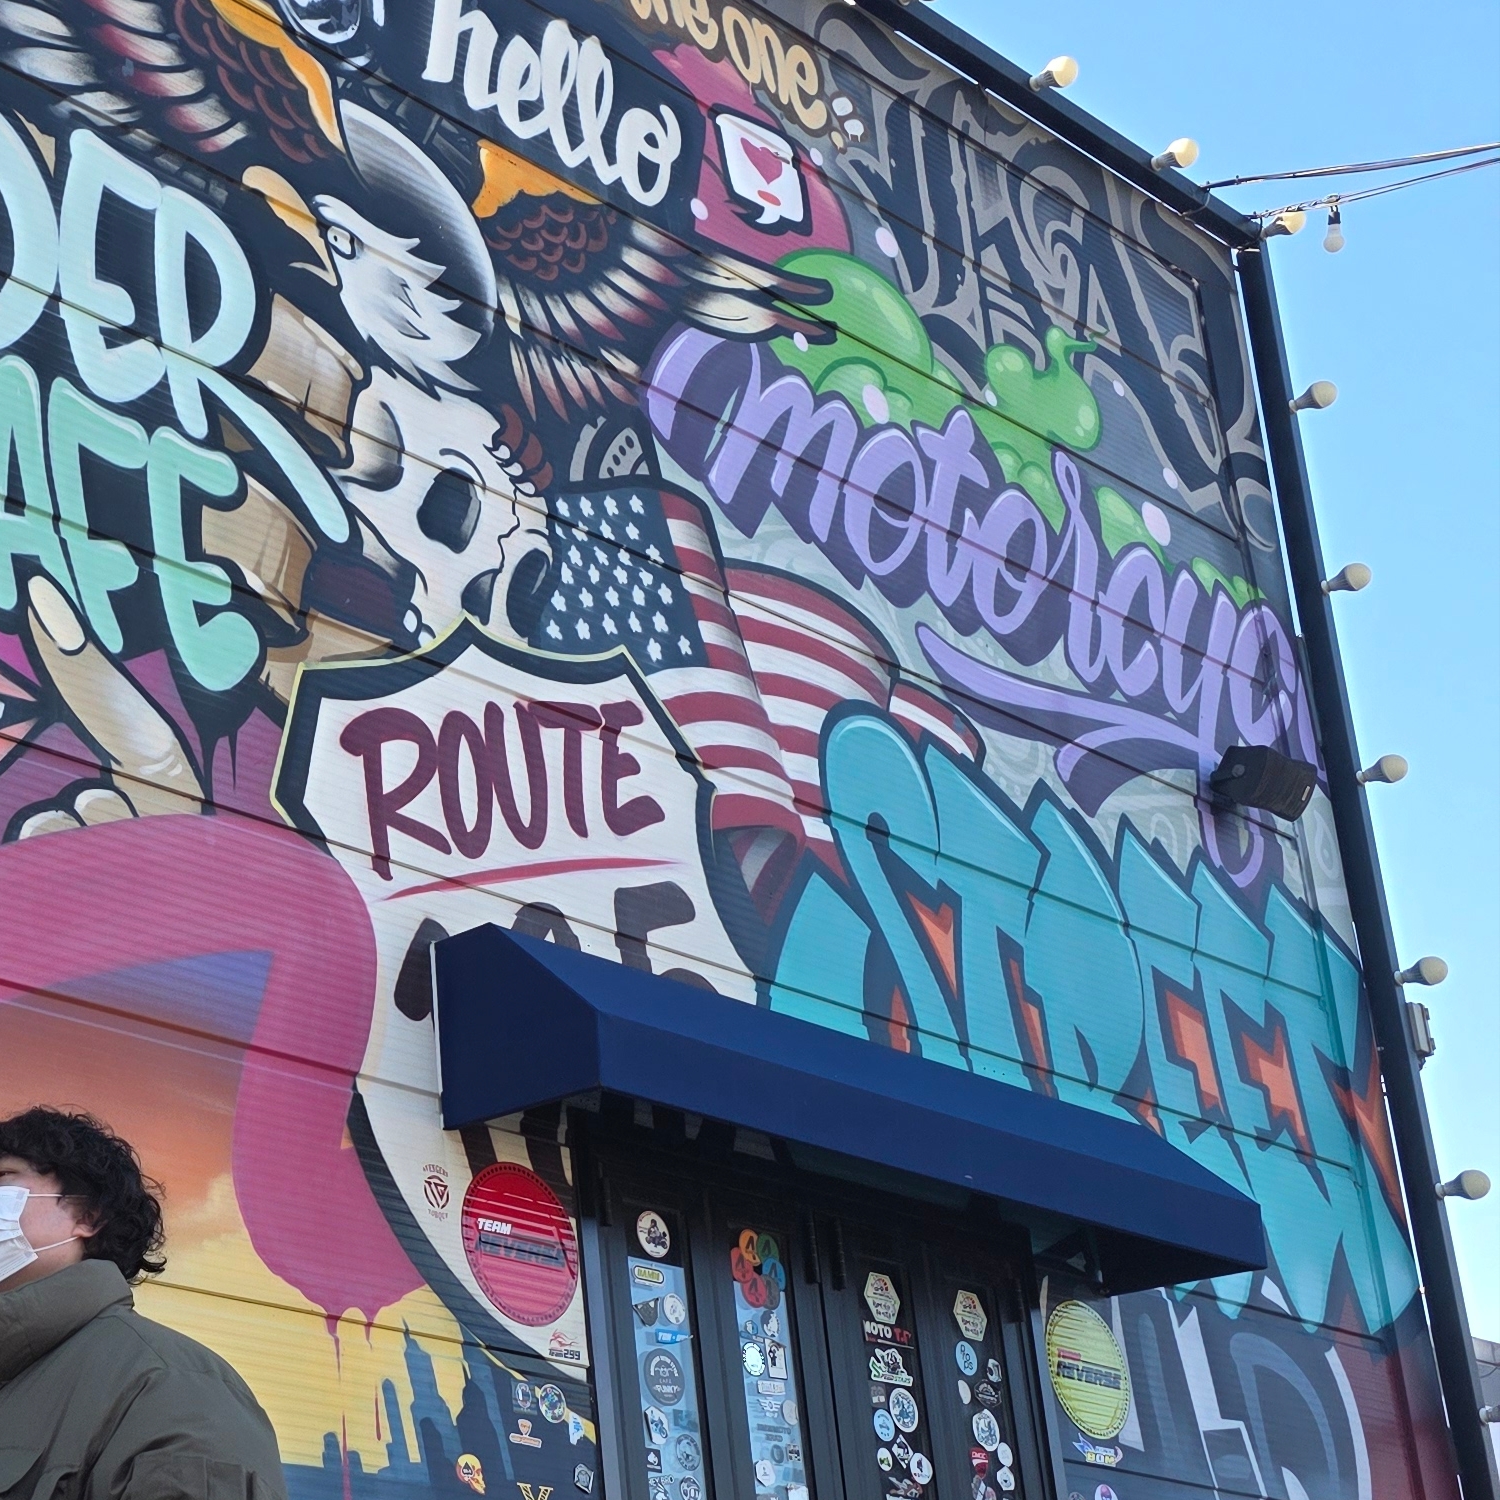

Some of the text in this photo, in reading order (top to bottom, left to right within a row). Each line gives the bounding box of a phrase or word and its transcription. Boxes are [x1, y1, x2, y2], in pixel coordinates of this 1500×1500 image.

[422, 0, 682, 206] hello
[340, 700, 666, 881] ROUTE
[477, 1217, 512, 1235] TEAM
[1056, 1362, 1122, 1389] REVERSE
